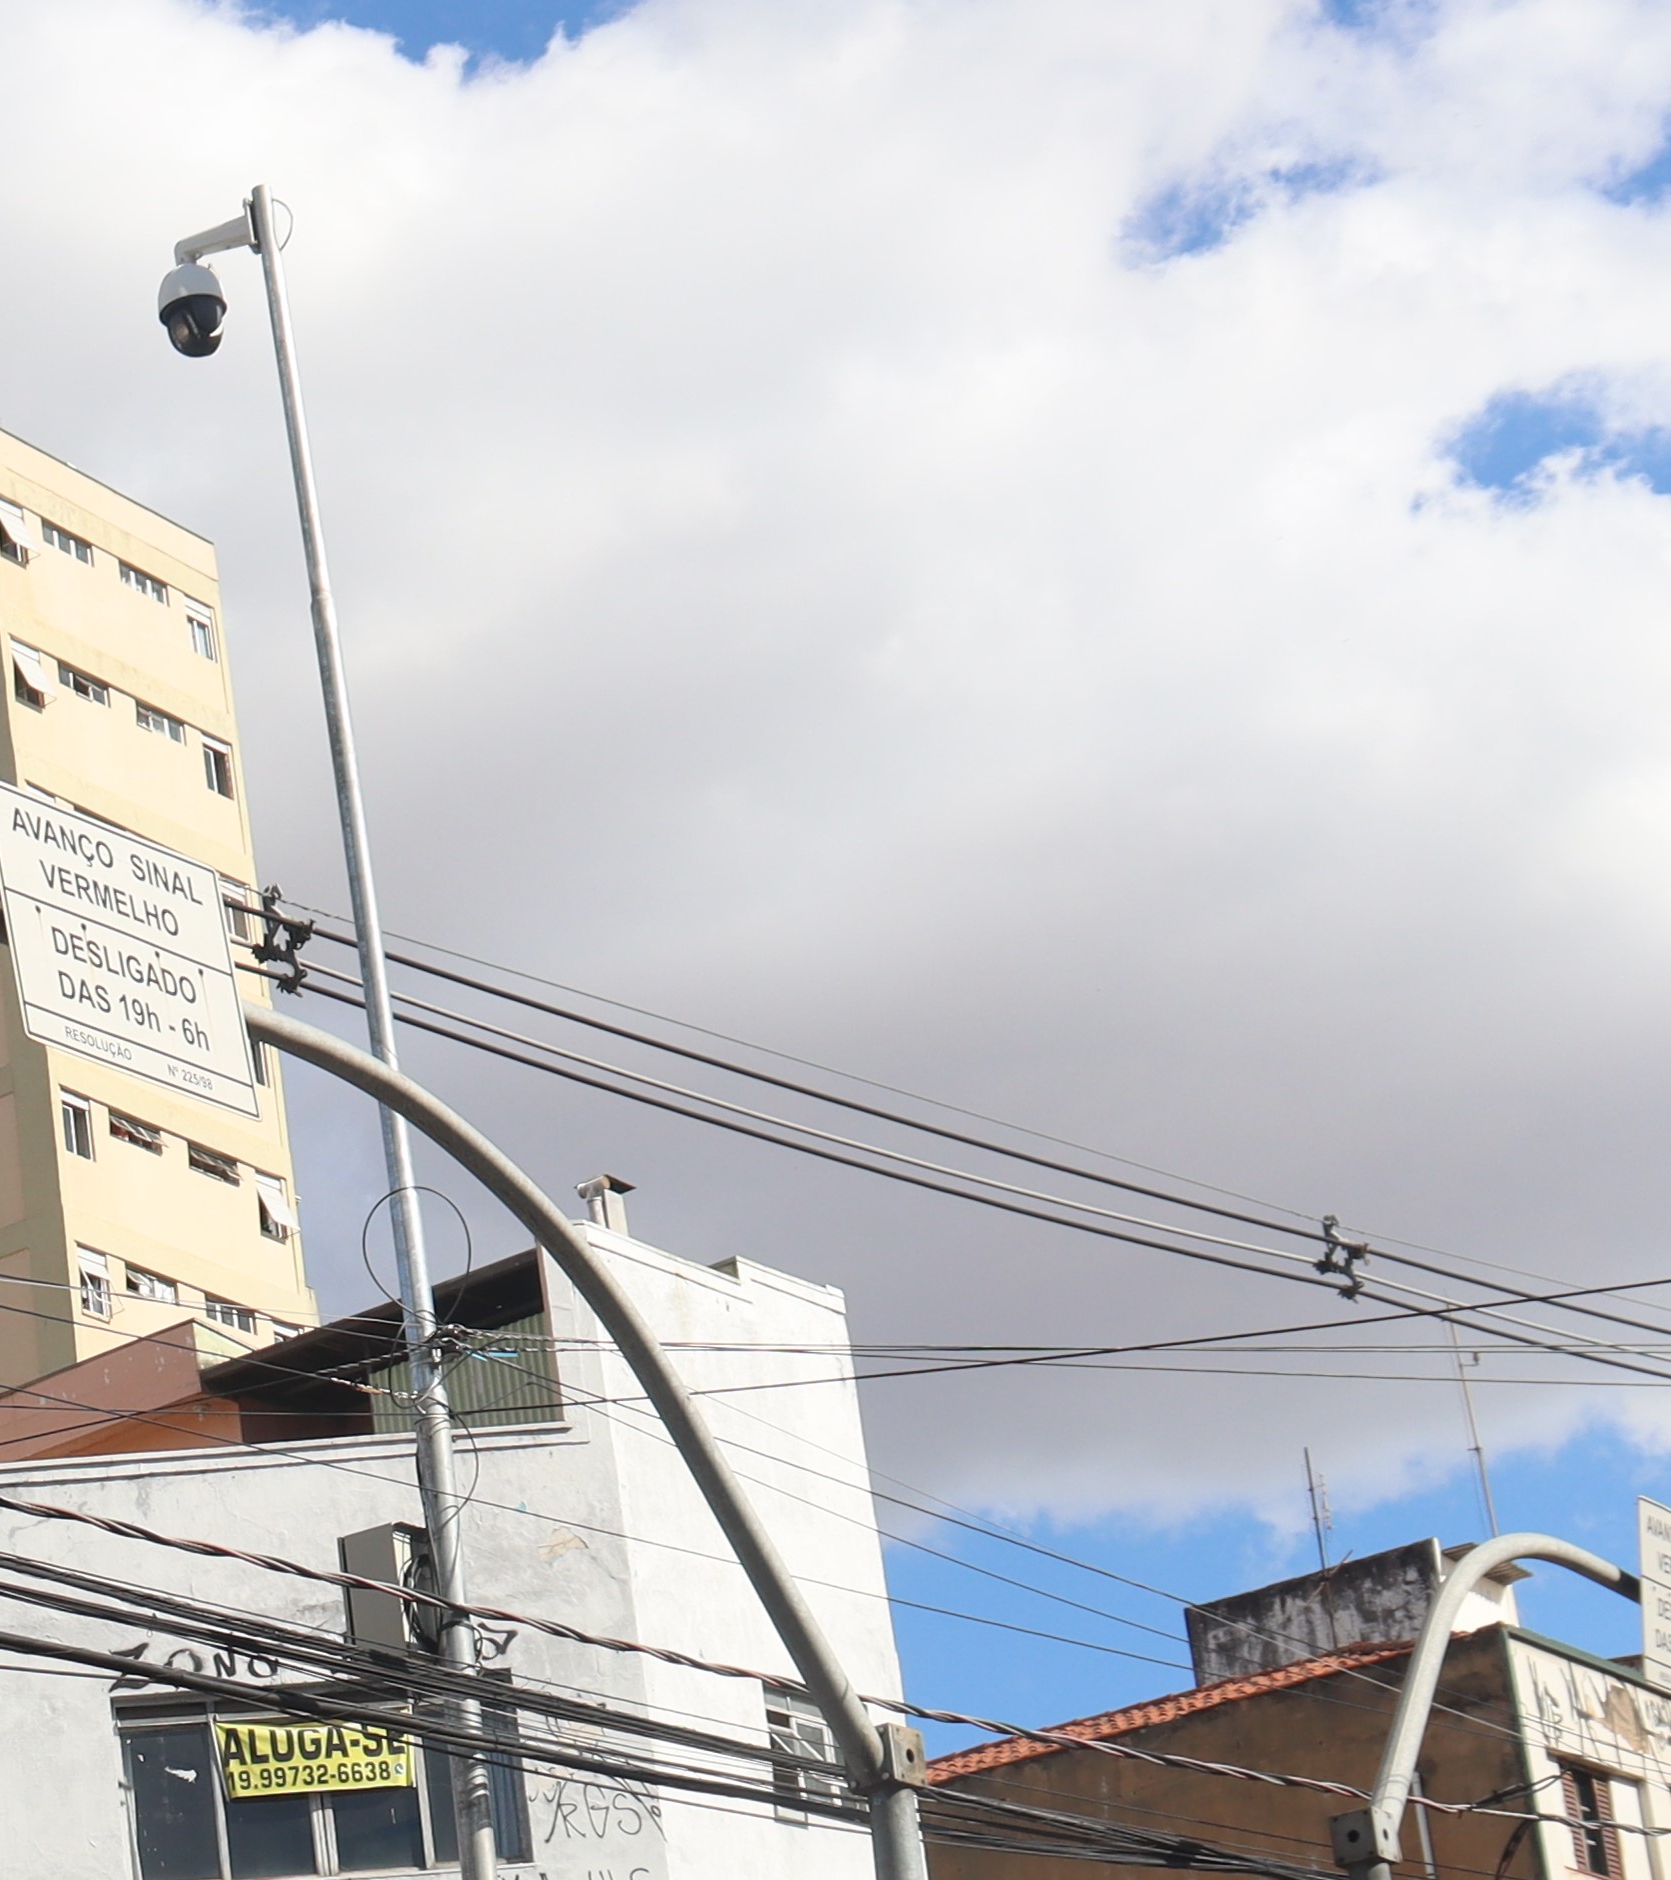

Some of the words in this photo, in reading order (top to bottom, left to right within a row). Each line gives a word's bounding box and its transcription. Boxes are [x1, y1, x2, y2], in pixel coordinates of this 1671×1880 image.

[12, 808, 114, 868] AVANÇO
[129, 854, 204, 906] SINAL
[39, 859, 180, 937] VERMELHO
[51, 926, 197, 1004] DESLIGADO
[58, 970, 112, 1014] DAS
[118, 994, 162, 1033] 19h
[182, 1018, 211, 1052] 6h
[65, 1025, 133, 1062] RESOLUÇÃO
[229, 1760, 392, 1791] 19.99732-6638
